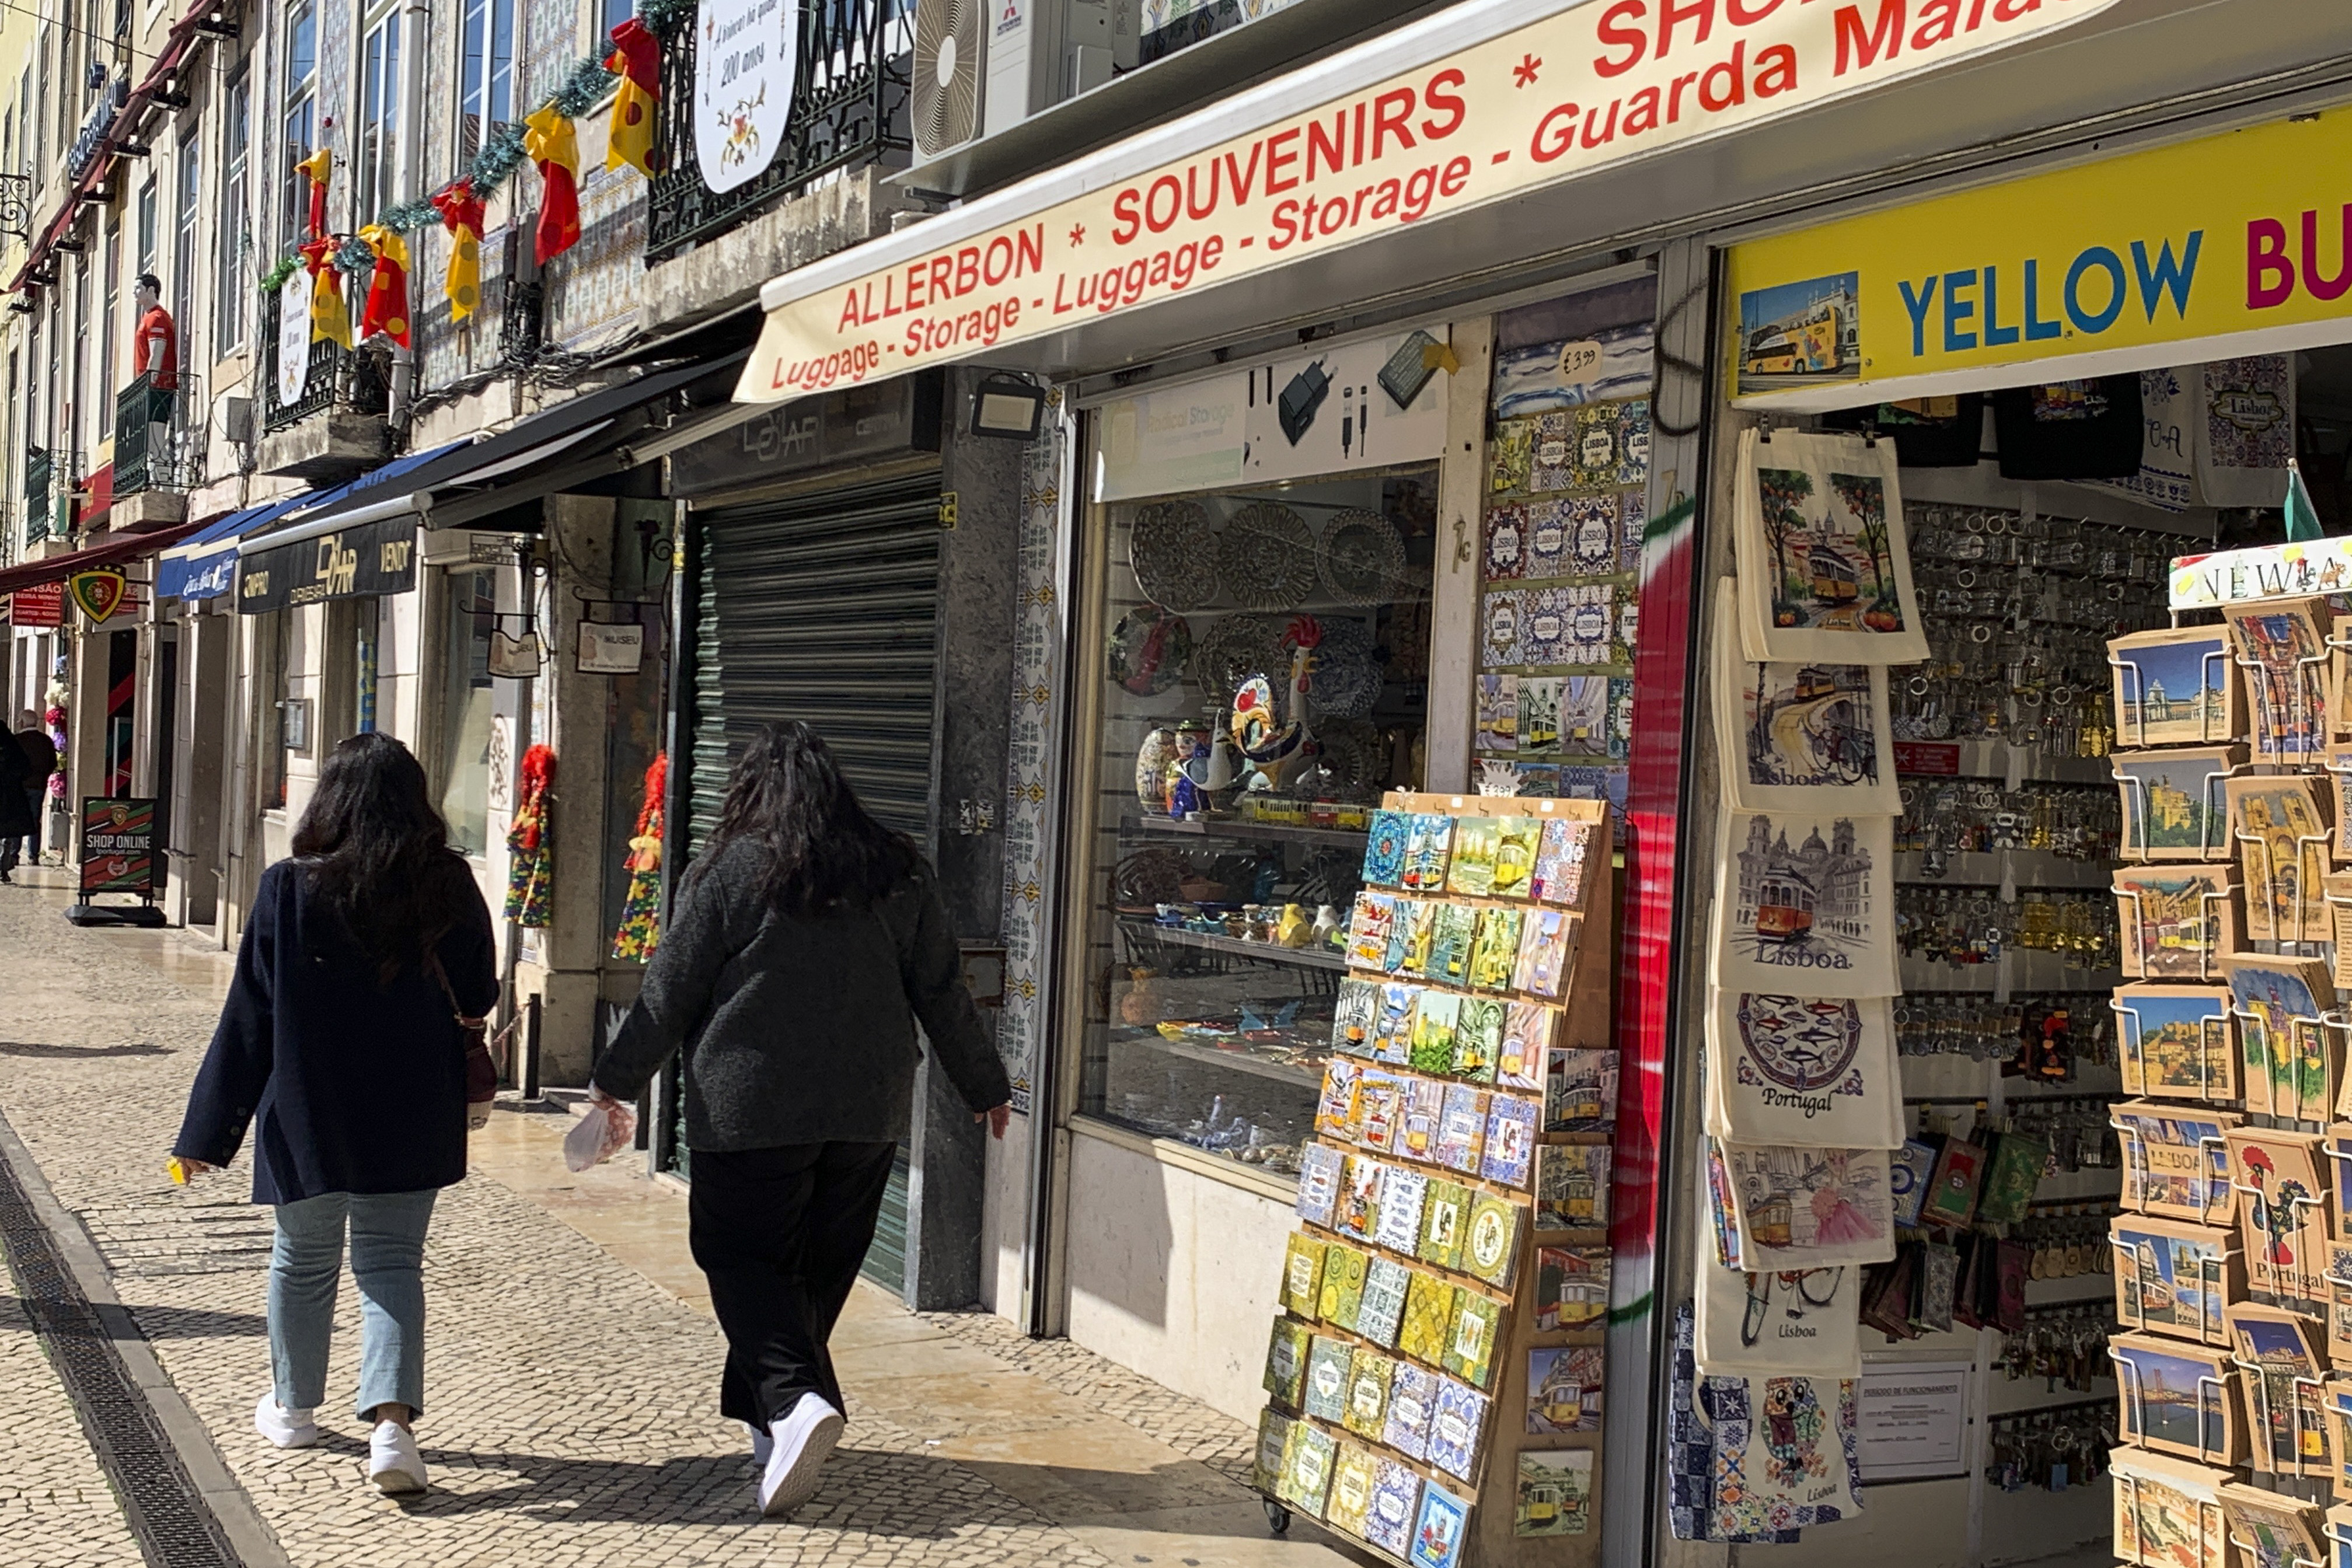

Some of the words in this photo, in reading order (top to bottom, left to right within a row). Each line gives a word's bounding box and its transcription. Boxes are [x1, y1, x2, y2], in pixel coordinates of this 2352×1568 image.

[721, 50, 740, 88] 200
[742, 41, 765, 73] anos
[838, 222, 1044, 333] ALLERBON
[1112, 69, 1465, 245] SOUVENIRS
[1594, 0, 1816, 78] SH
[772, 339, 880, 391] Luggage
[903, 294, 1020, 347] Storage
[1052, 235, 1223, 314] Luggage
[1268, 155, 1471, 251] Storage
[1531, 43, 1796, 163] Guarda
[1898, 231, 2204, 357] YELLOW
[1585, 437, 1609, 451] LISBOA
[1493, 537, 1518, 549] LISBOA
[1580, 529, 1607, 542] LISBOA
[380, 539, 413, 573] VEND
[1750, 767, 1823, 787] Lisboa
[86, 834, 114, 848] SHOP
[116, 836, 151, 850] ONLINE
[1761, 1087, 1837, 1119] Portugal
[2255, 1262, 2325, 1290] Portugal
[1778, 1323, 1817, 1339] Lisboa
[1357, 1384, 1379, 1400] LISBOA
[1893, 1387, 1901, 1396] DE
[1806, 1483, 1838, 1503] Lisboa
